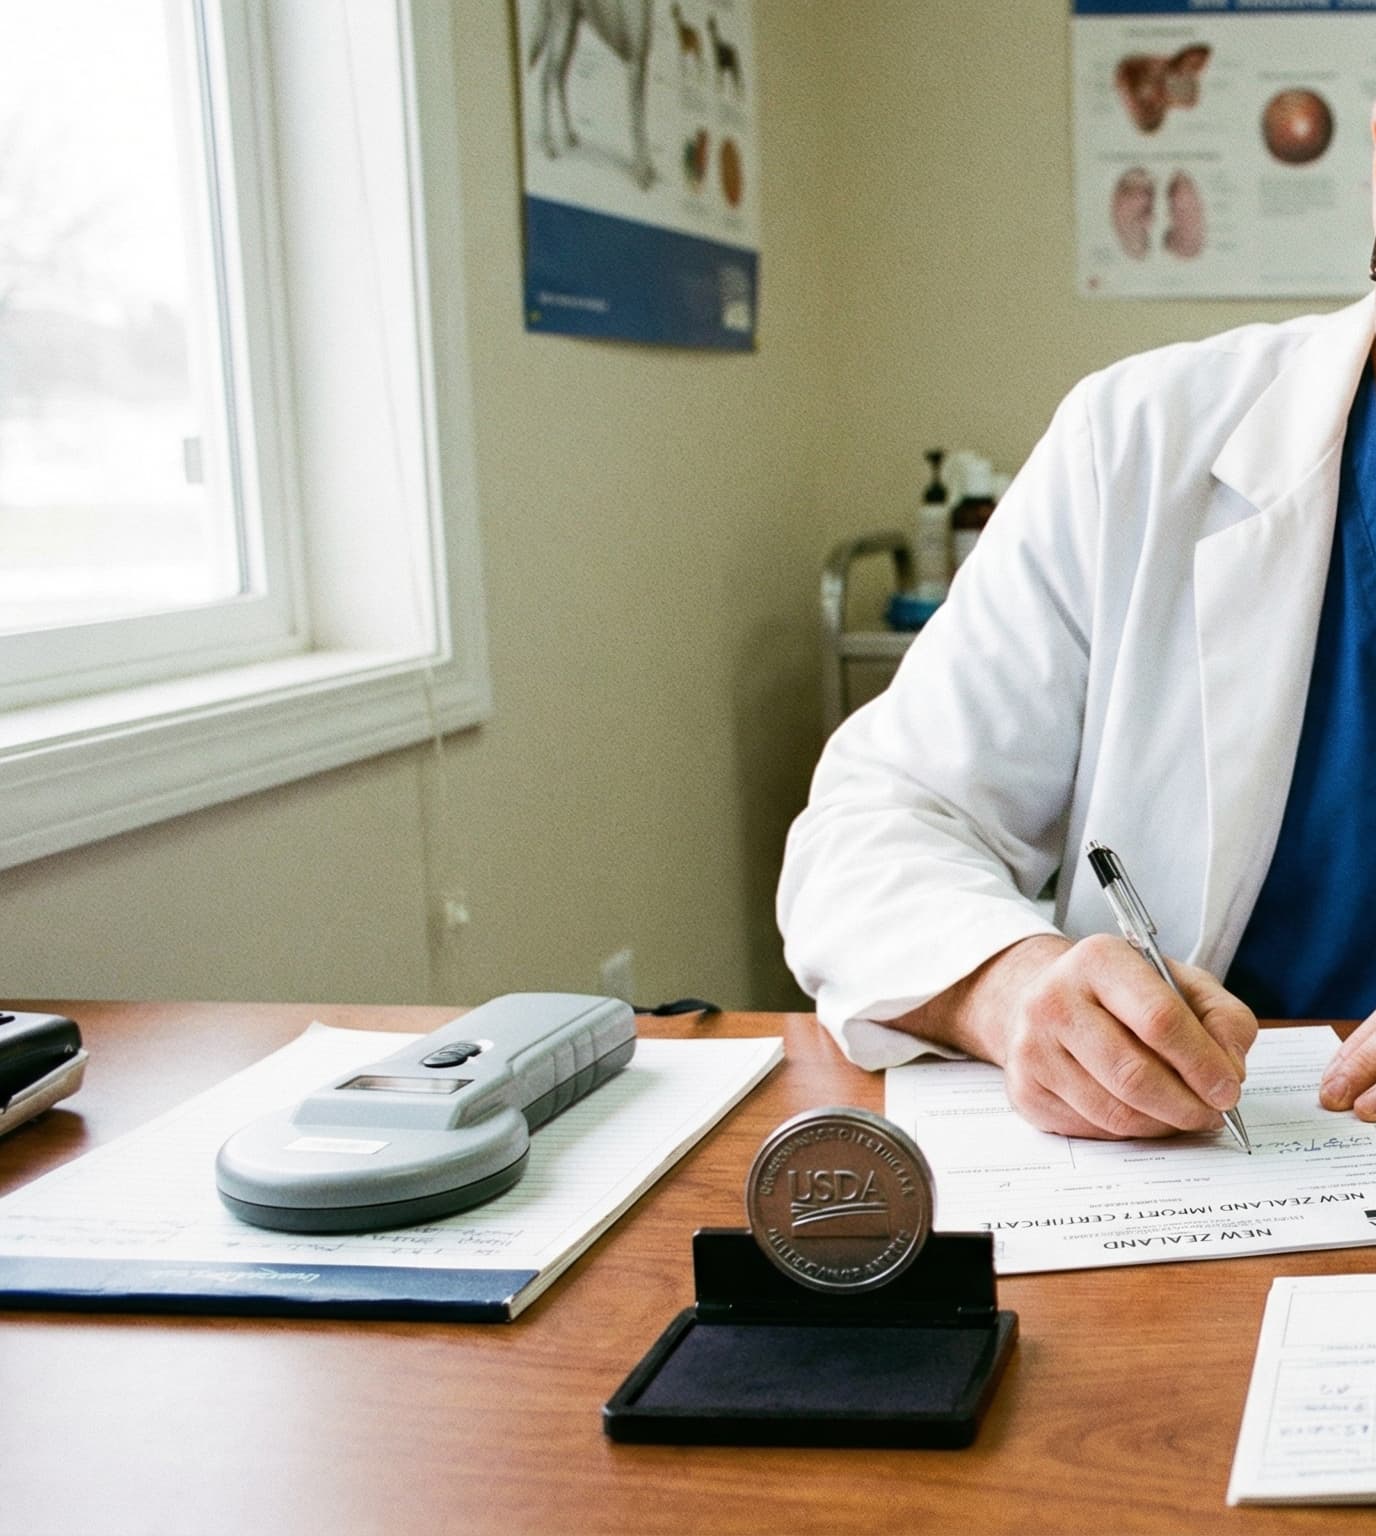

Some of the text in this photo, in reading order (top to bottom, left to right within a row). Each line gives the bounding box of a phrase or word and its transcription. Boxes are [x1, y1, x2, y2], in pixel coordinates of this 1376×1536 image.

[787, 1169, 879, 1202] USDA
[1220, 1196, 1312, 1212] ZEALAND
[1320, 1192, 1365, 1202] NEW
[1104, 1227, 1272, 1250] NEW ZEALAND
